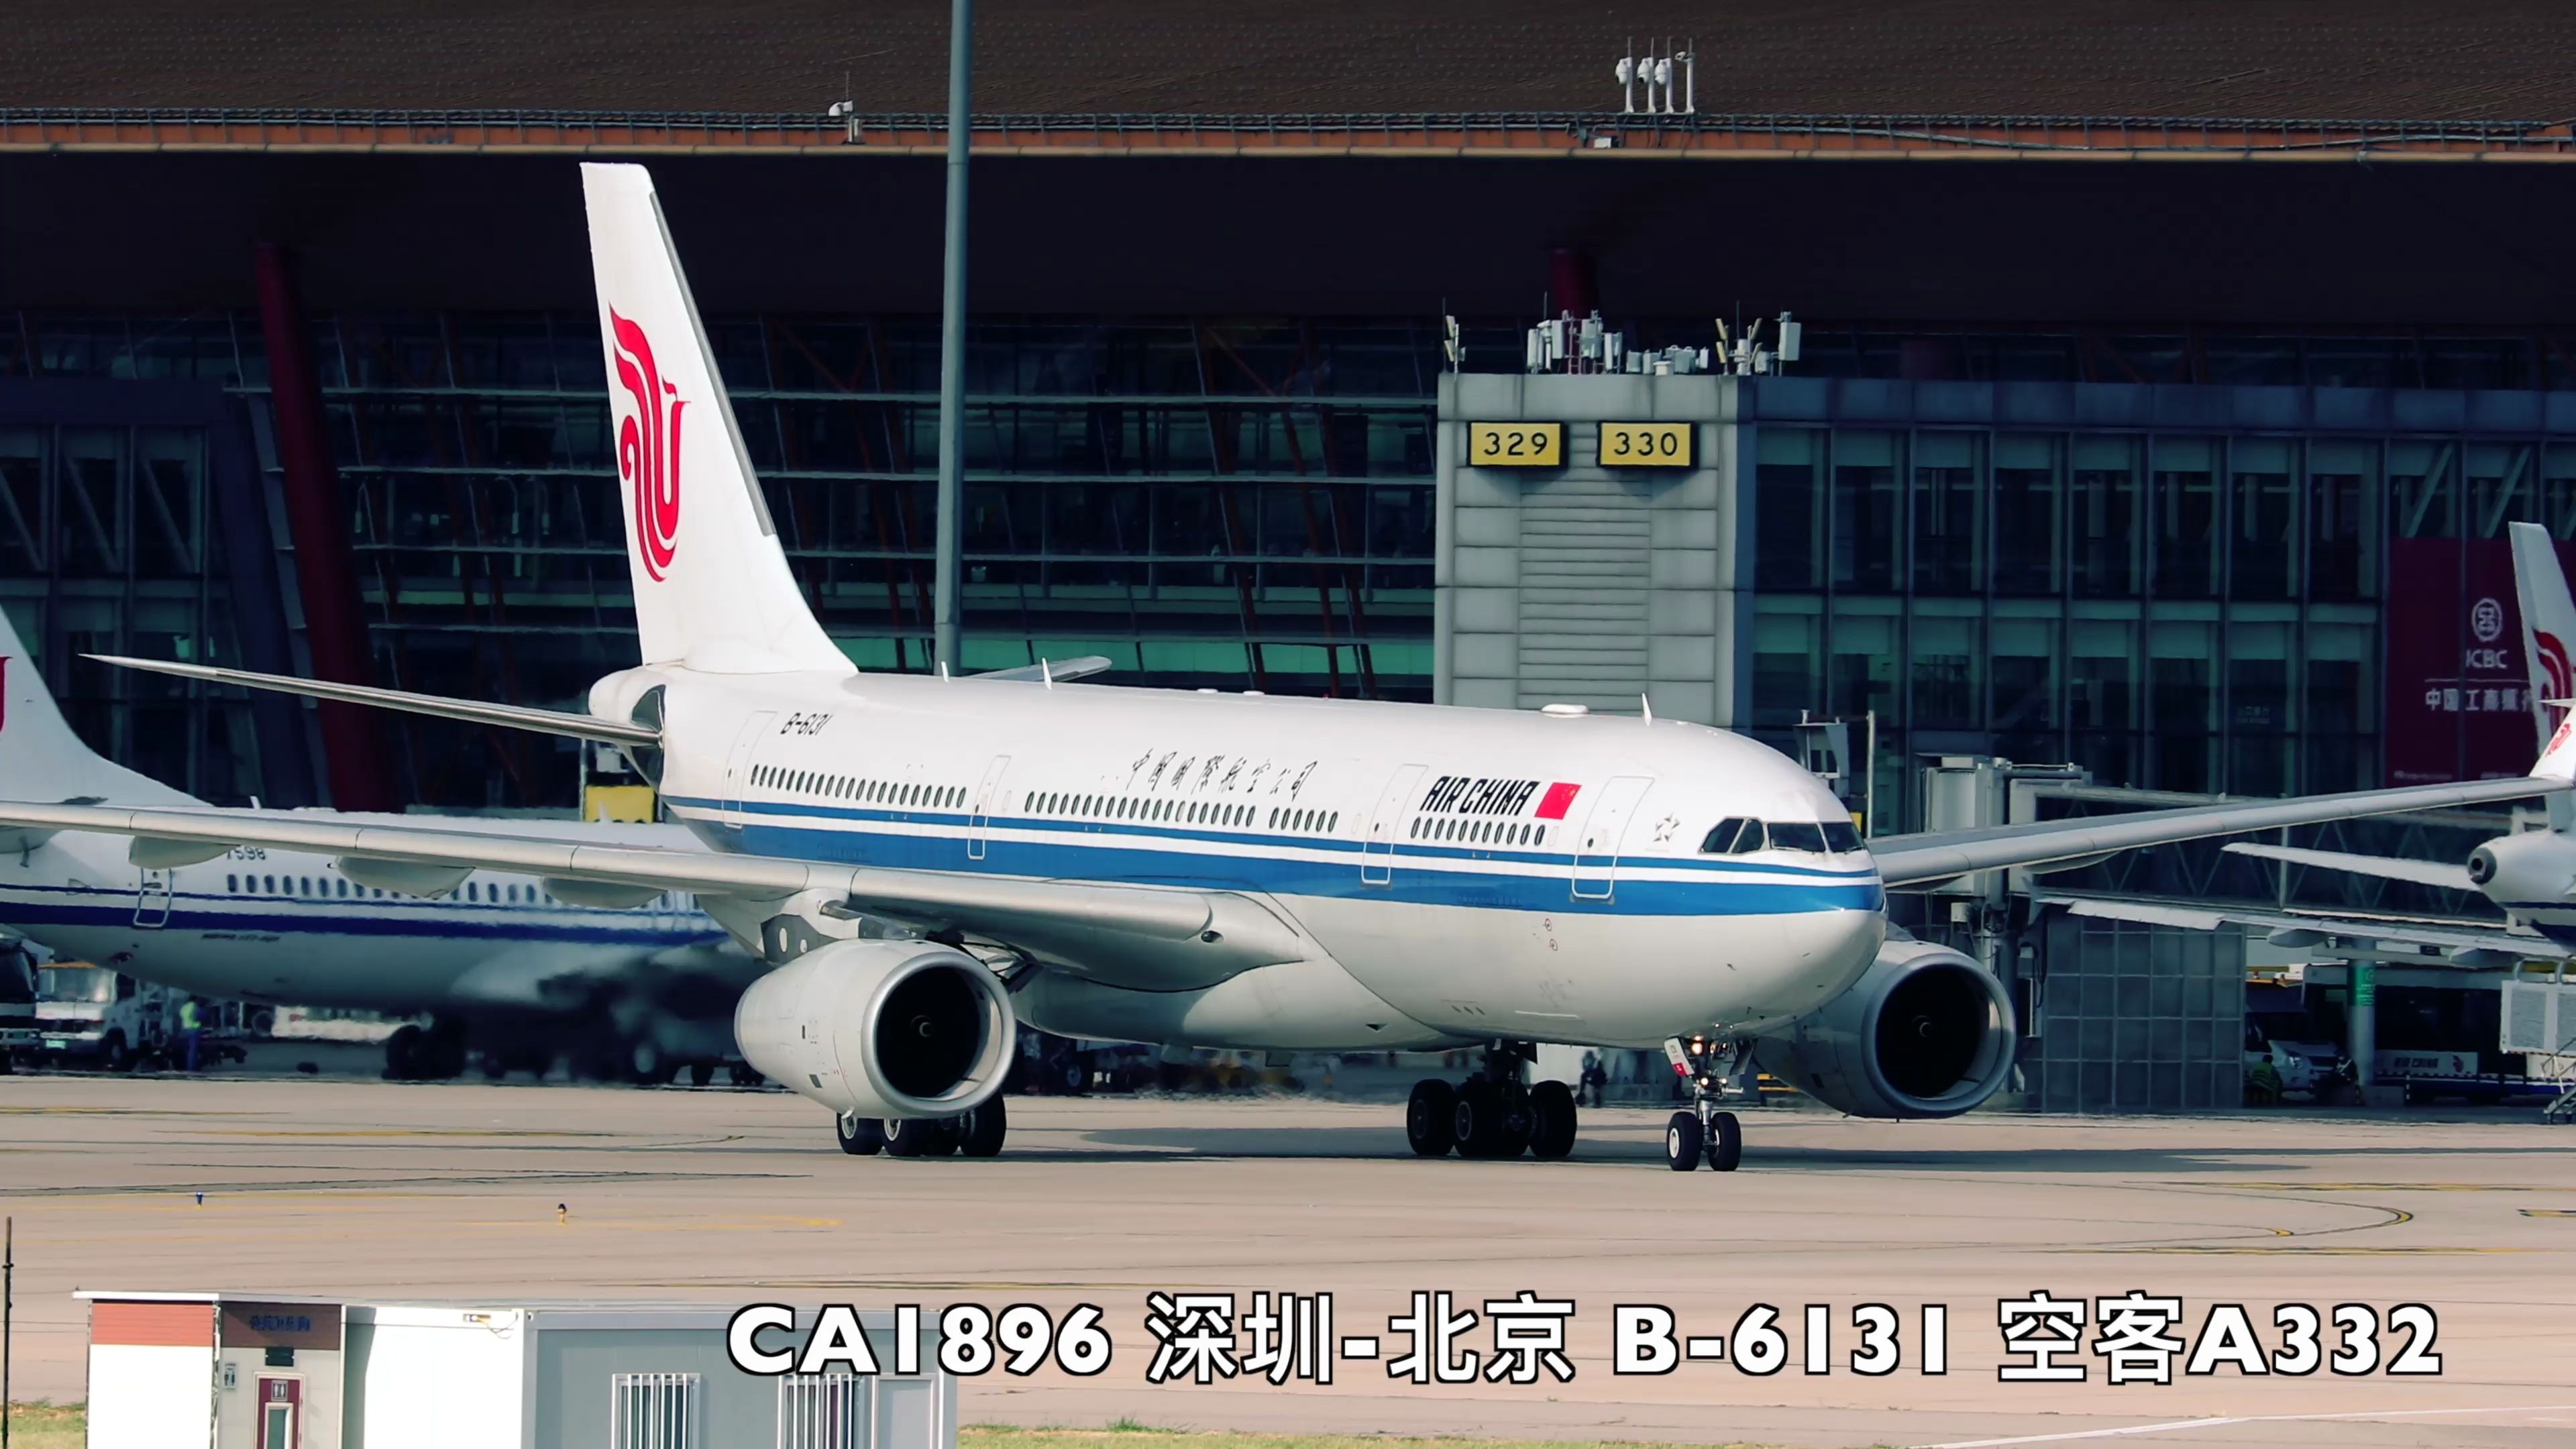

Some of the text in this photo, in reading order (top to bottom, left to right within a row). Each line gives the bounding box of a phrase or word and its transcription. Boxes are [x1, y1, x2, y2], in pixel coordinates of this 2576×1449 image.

[1483, 431, 1548, 457] 329
[1613, 431, 1678, 457] 330
[2465, 649, 2508, 669] ICBC
[780, 712, 833, 737] B-6131
[1419, 775, 1541, 816] AIR CHINA
